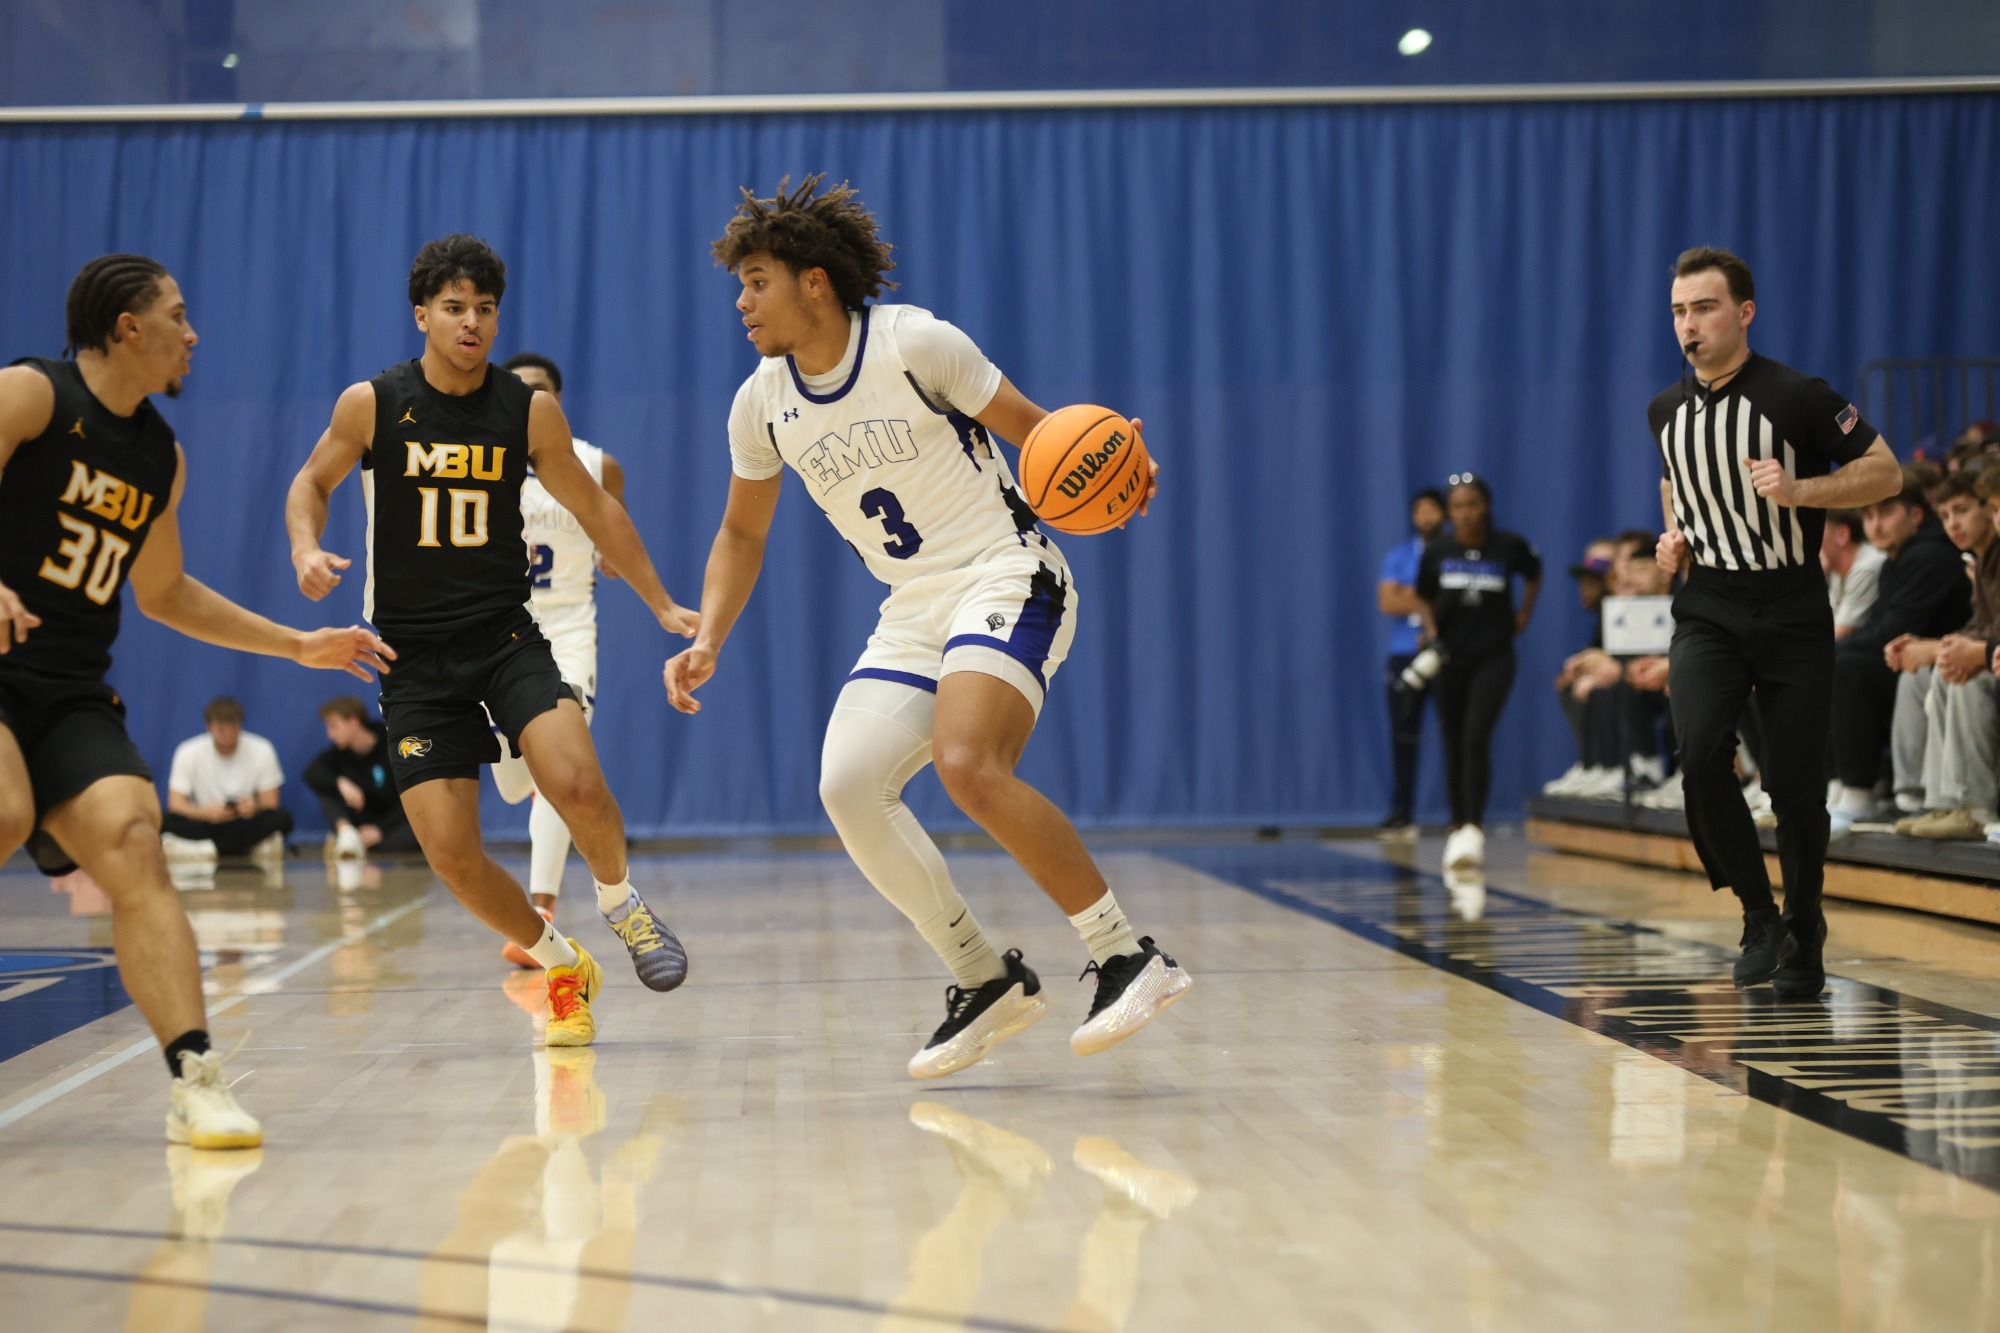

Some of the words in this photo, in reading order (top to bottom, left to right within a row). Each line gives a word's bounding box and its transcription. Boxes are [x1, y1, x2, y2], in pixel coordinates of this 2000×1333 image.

[403, 441, 507, 481] MBU
[798, 419, 919, 496] EMU
[1056, 430, 1126, 499] Wilson
[59, 459, 154, 531] MBU
[416, 487, 489, 547] 10
[521, 495, 580, 536] MU
[859, 487, 924, 560] 3
[38, 510, 131, 606] 30
